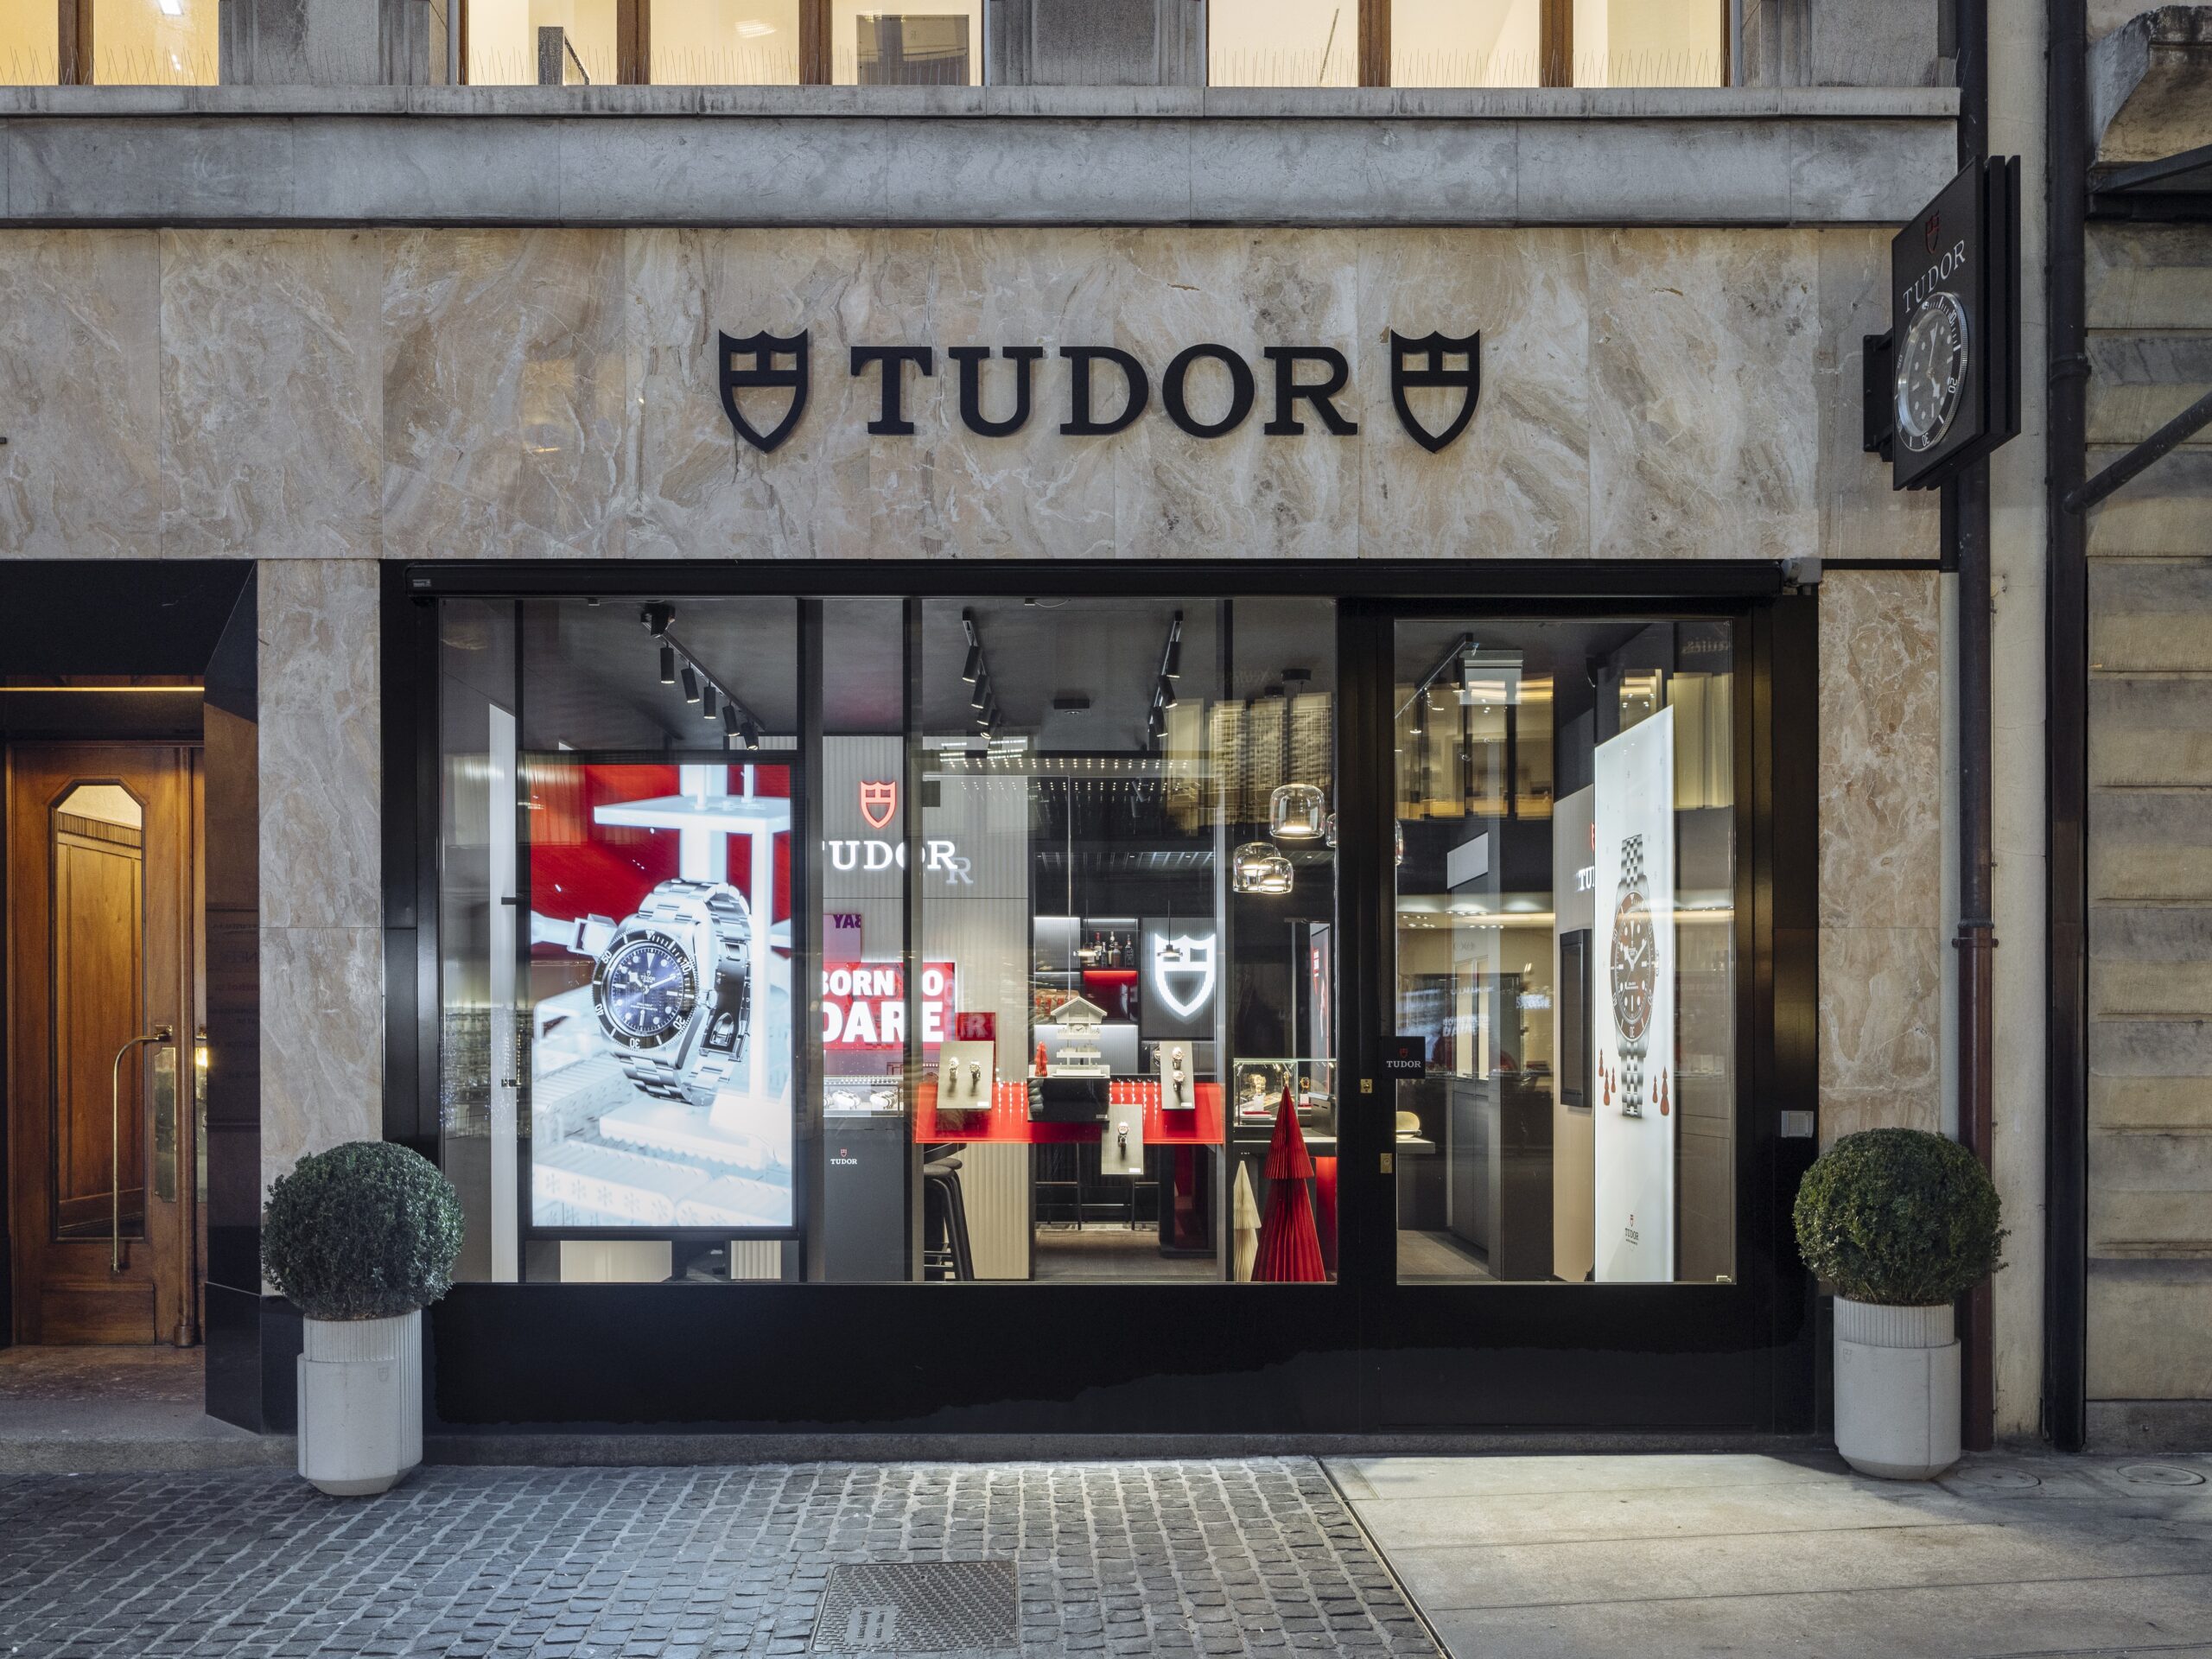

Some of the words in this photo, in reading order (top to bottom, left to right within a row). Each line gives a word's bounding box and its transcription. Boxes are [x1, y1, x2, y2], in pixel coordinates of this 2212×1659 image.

[1903, 239, 1966, 315] TUDOR
[850, 343, 1358, 439] TUDOR
[823, 841, 957, 870] UDR
[1386, 1060, 1421, 1069] TUDOR
